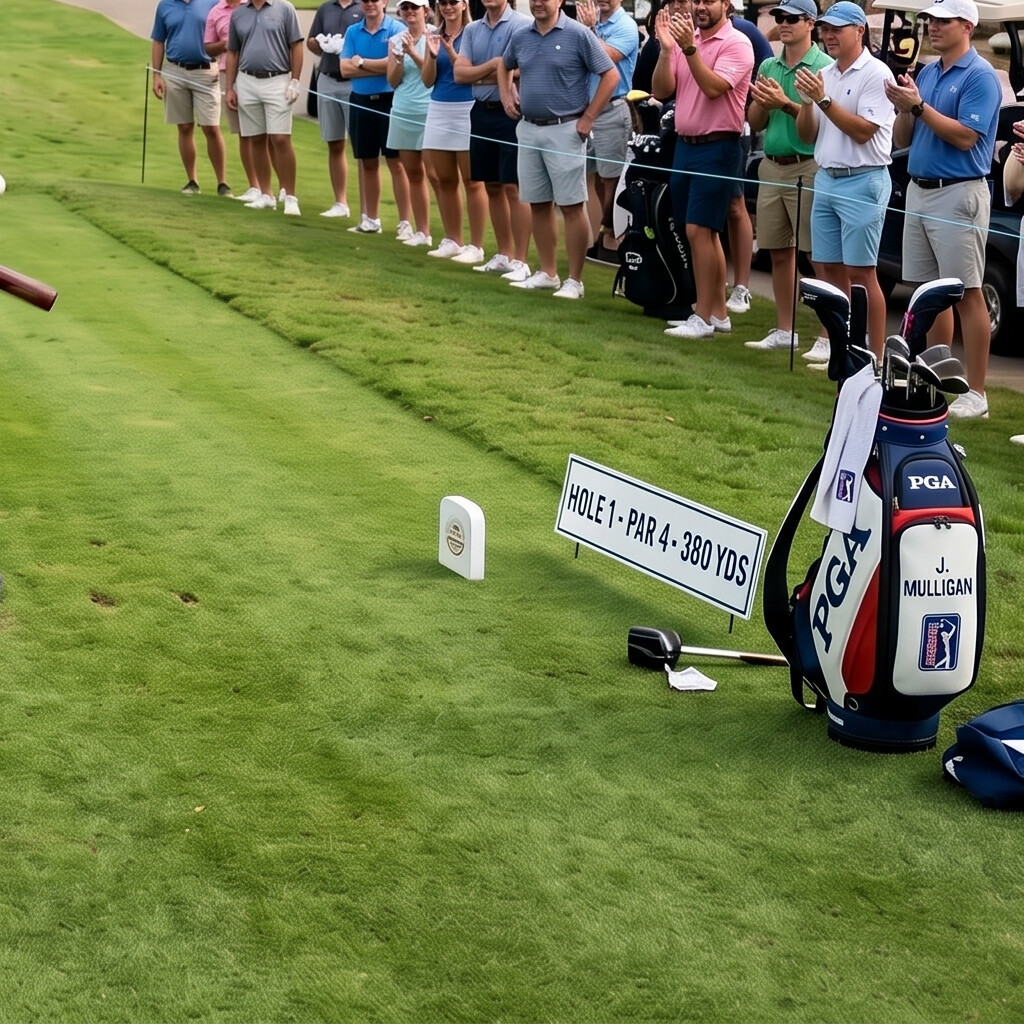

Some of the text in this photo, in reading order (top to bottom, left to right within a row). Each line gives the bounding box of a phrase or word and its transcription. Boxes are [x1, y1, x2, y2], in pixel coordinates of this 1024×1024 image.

[908, 475, 957, 490] PGA
[567, 483, 606, 525] HOLE
[608, 499, 616, 529] 1
[625, 508, 657, 547] PAR
[658, 523, 671, 553] 4
[680, 531, 712, 571] 380
[715, 544, 749, 587] YDS
[935, 557, 949, 574] J.
[813, 527, 872, 654] PGA
[903, 578, 973, 598] MULLIGAN
